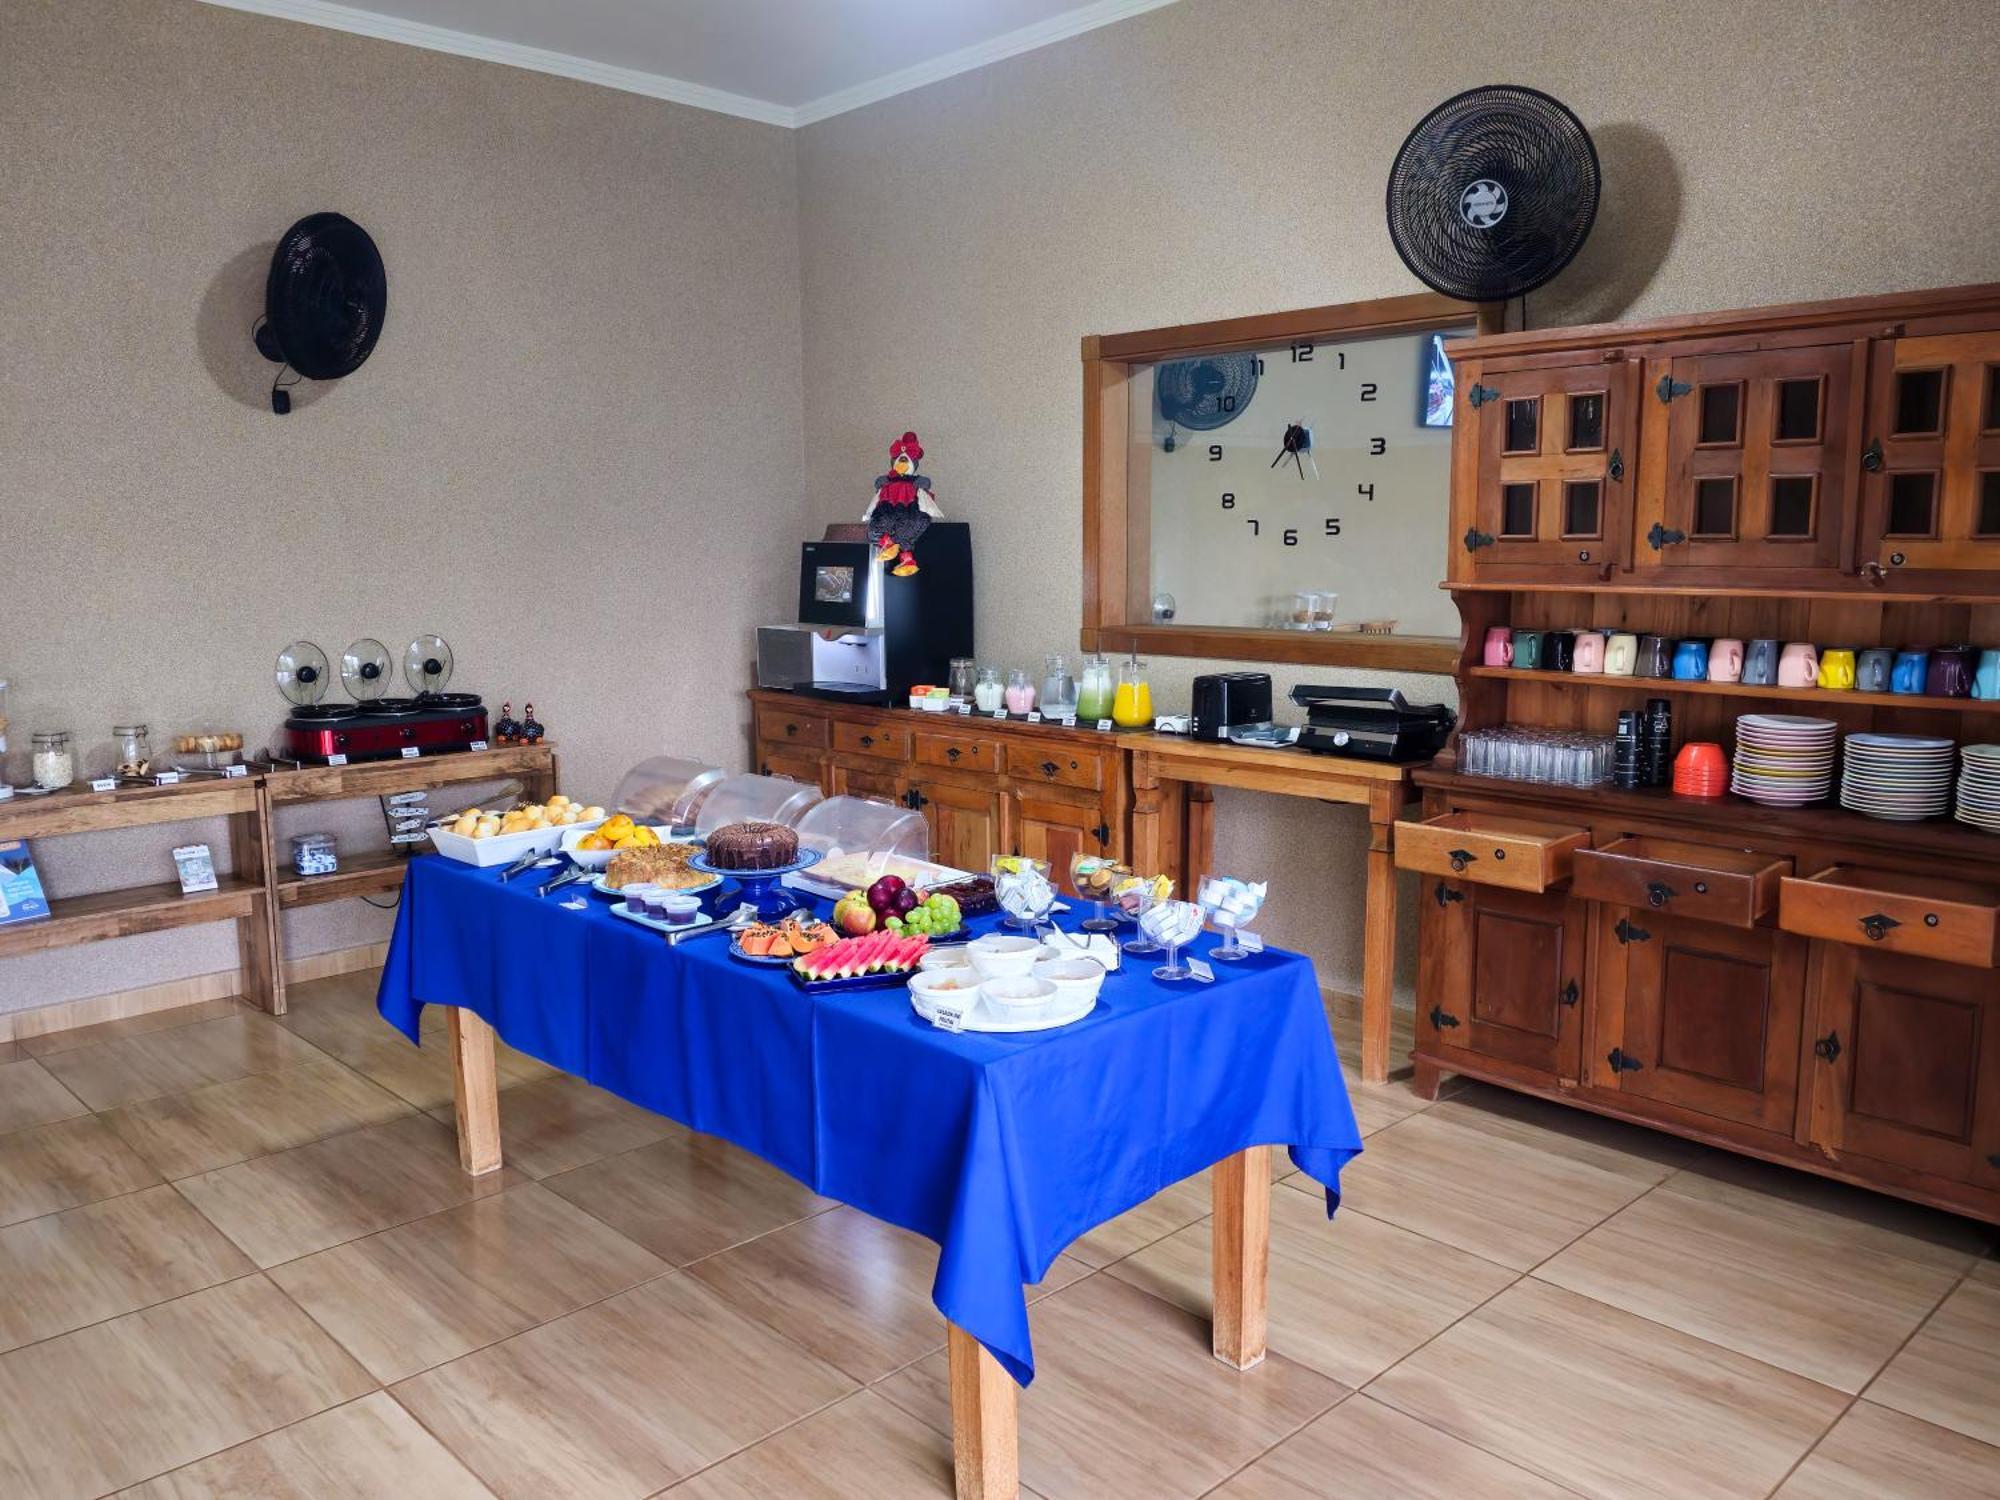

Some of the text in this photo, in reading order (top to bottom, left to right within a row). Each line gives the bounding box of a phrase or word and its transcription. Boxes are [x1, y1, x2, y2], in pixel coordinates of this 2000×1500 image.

[1291, 344, 1314, 363] 12
[1338, 353, 1345, 369] 1
[1250, 359, 1264, 376] 11
[1361, 383, 1377, 401] 2
[1216, 396, 1236, 412] 10
[1209, 445, 1222, 461] 9
[1370, 437, 1386, 455] 3
[1358, 484, 1374, 501] 4
[1222, 493, 1235, 509] 8
[1247, 520, 1259, 536] 7
[1325, 519, 1340, 535] 5
[1283, 529, 1298, 546] 6
